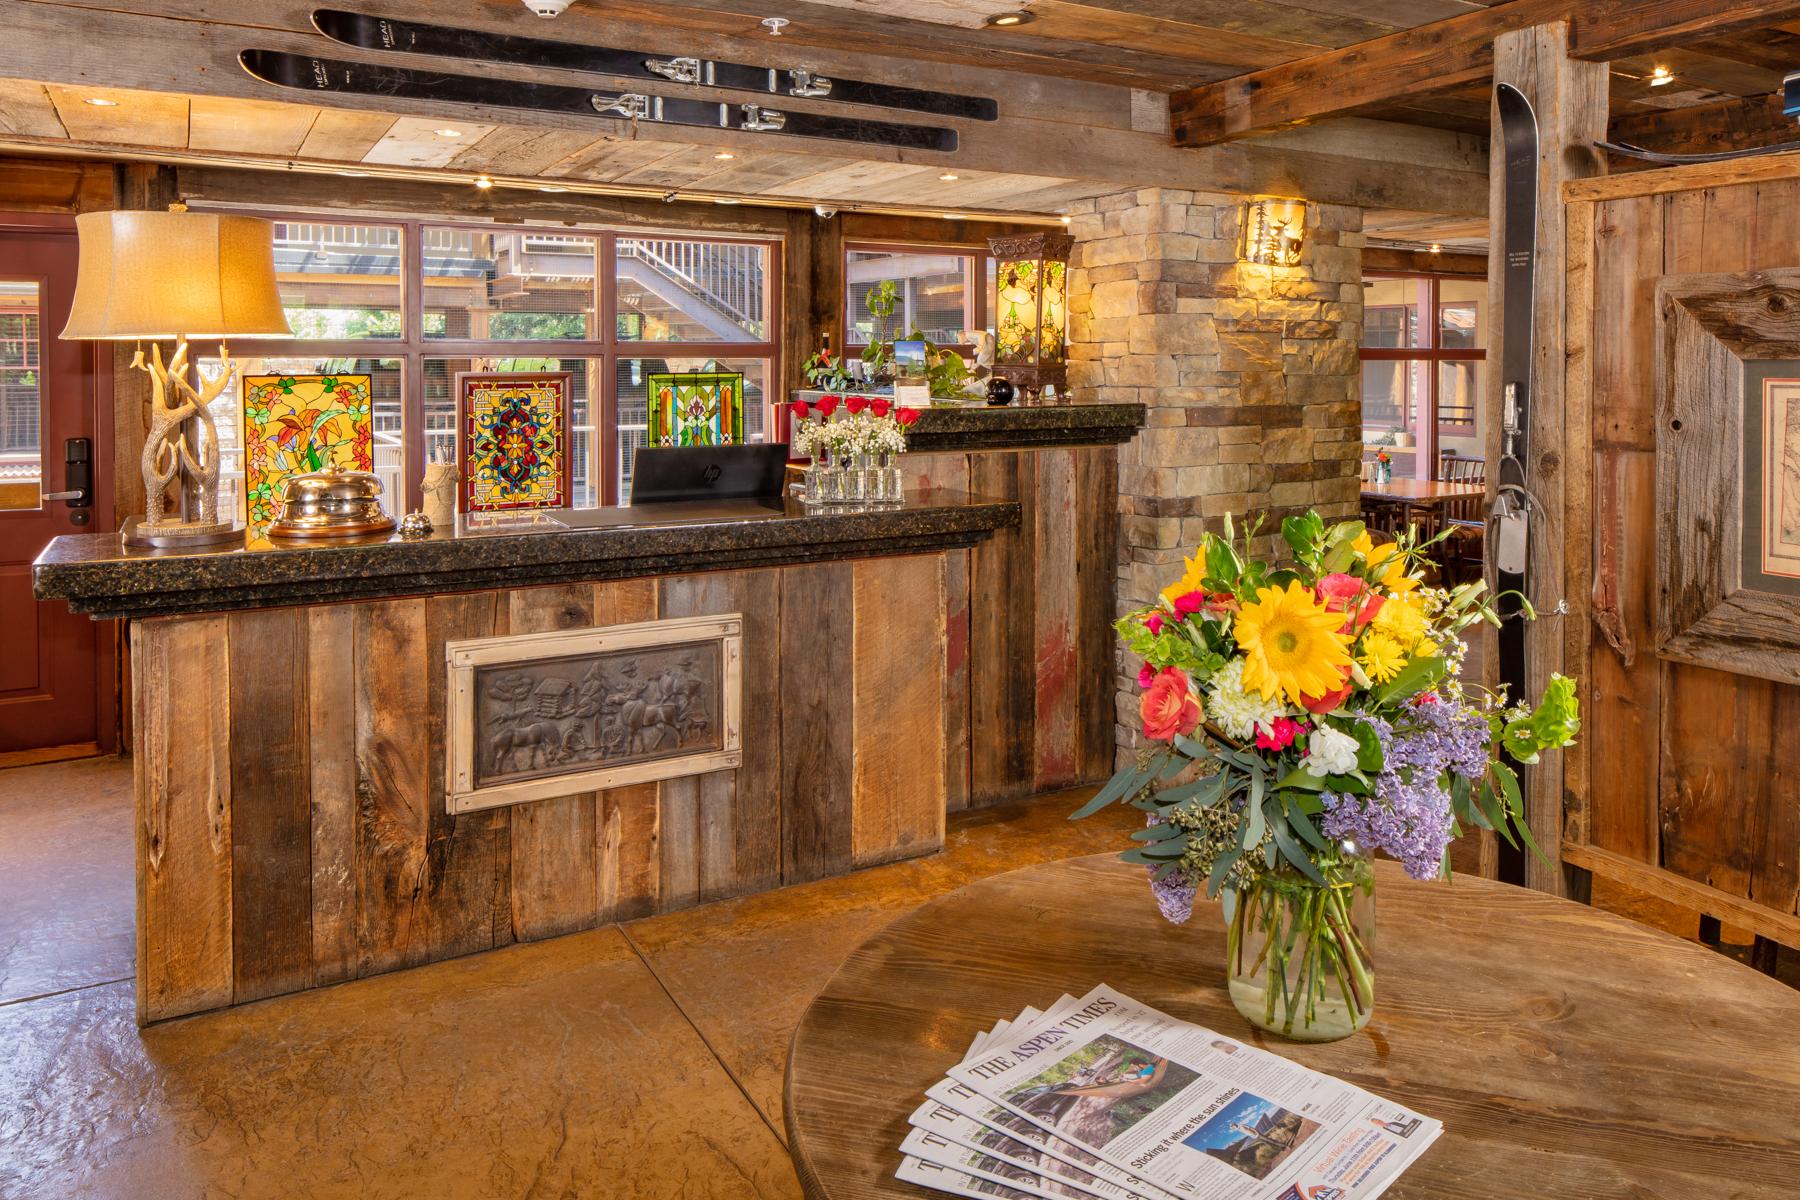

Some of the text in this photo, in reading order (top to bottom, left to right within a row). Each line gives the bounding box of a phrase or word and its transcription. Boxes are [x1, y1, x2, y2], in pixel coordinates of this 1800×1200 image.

[379, 20, 391, 48] HEAD
[312, 60, 324, 88] HEAD
[703, 463, 721, 483] hp
[968, 1056, 1016, 1080] THE
[1011, 1026, 1070, 1062] ASPEN
[1060, 997, 1118, 1030] TIMES
[1130, 1142, 1168, 1169] Sticking
[1163, 1138, 1172, 1147] it
[1170, 1122, 1194, 1142] where
[1188, 1112, 1207, 1126] the
[1203, 1103, 1219, 1116] sun
[1215, 1087, 1241, 1106] shines
